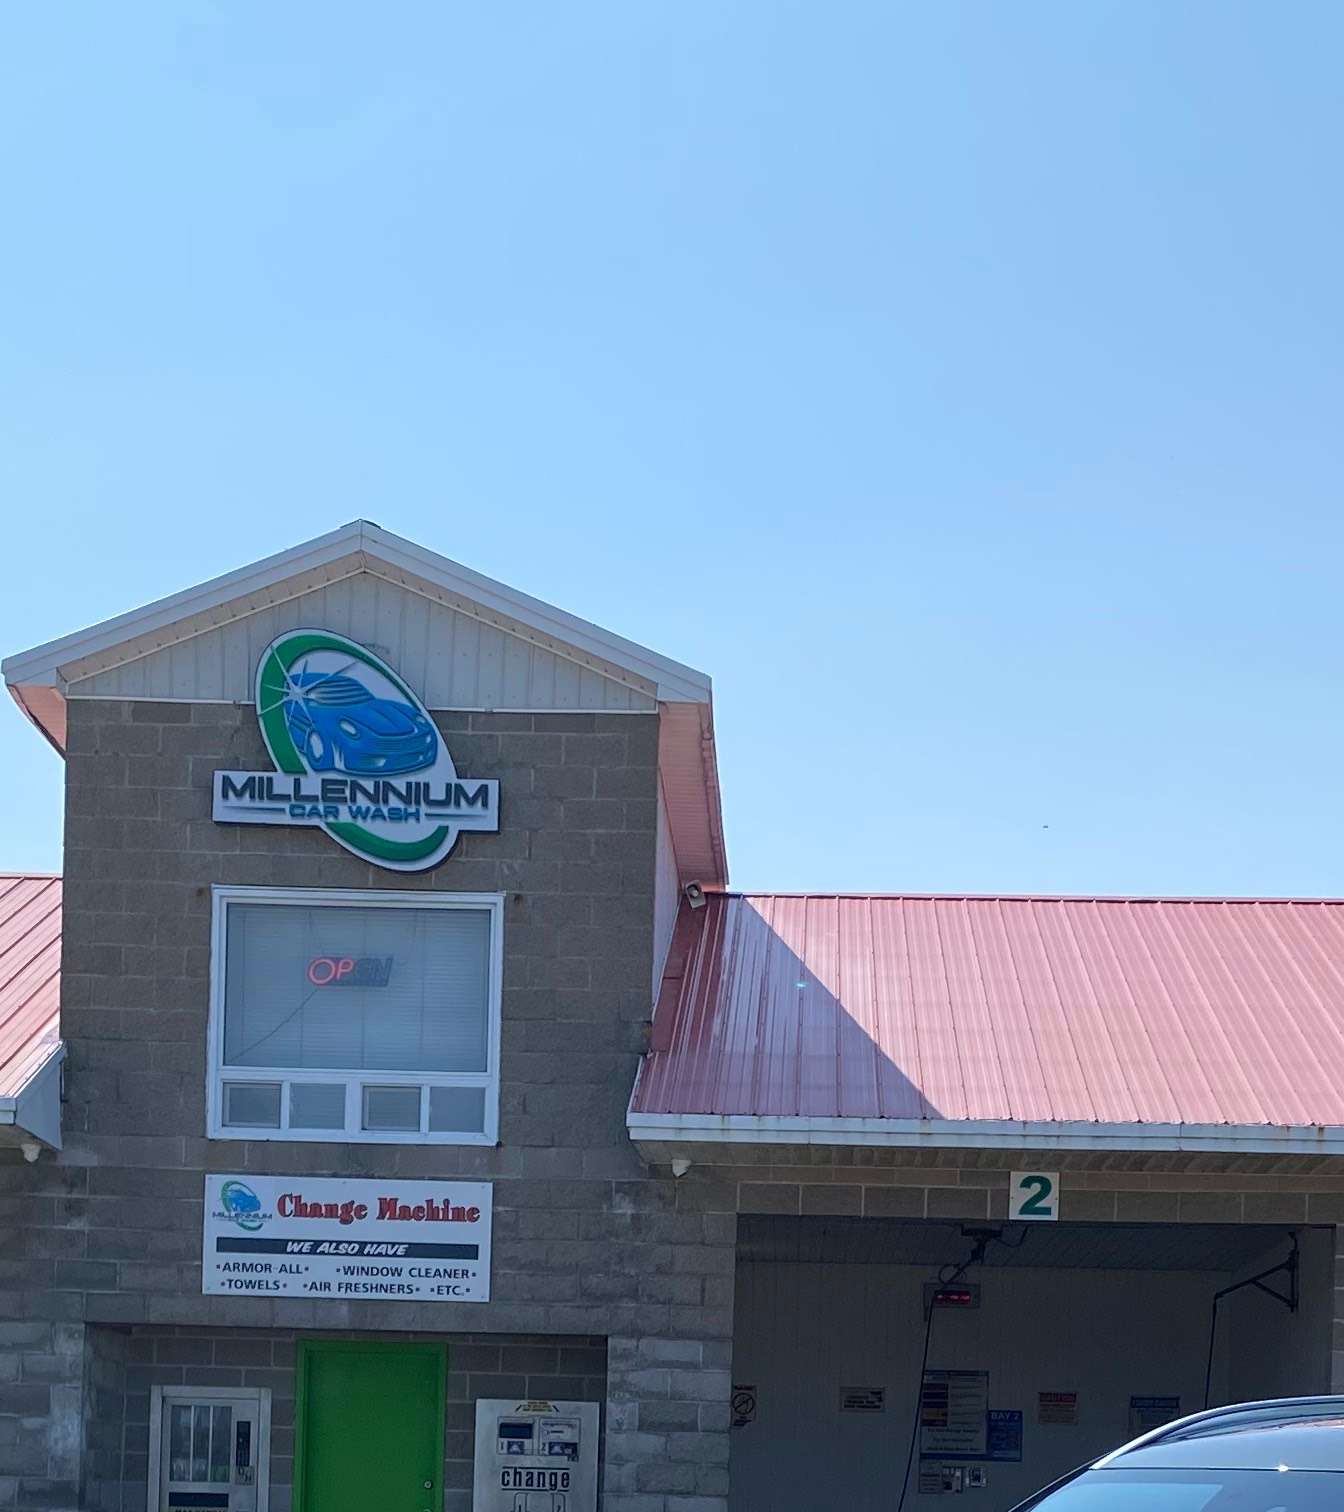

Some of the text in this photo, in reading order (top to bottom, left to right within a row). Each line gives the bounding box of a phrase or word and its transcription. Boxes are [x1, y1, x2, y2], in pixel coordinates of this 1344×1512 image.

[221, 774, 489, 809] MILLENNIUM
[288, 803, 421, 822] CAR WASH
[1018, 1175, 1052, 1216] 2
[277, 1192, 481, 1225] Change Machine
[286, 1240, 409, 1256] WE ALSO HAVE
[342, 1265, 403, 1277] WINDOW
[408, 1267, 470, 1279] CLEANER
[226, 1279, 281, 1290] TOWELS
[308, 1281, 331, 1292] AIR
[337, 1282, 414, 1295] FRESHNERS
[501, 1467, 571, 1491] change
